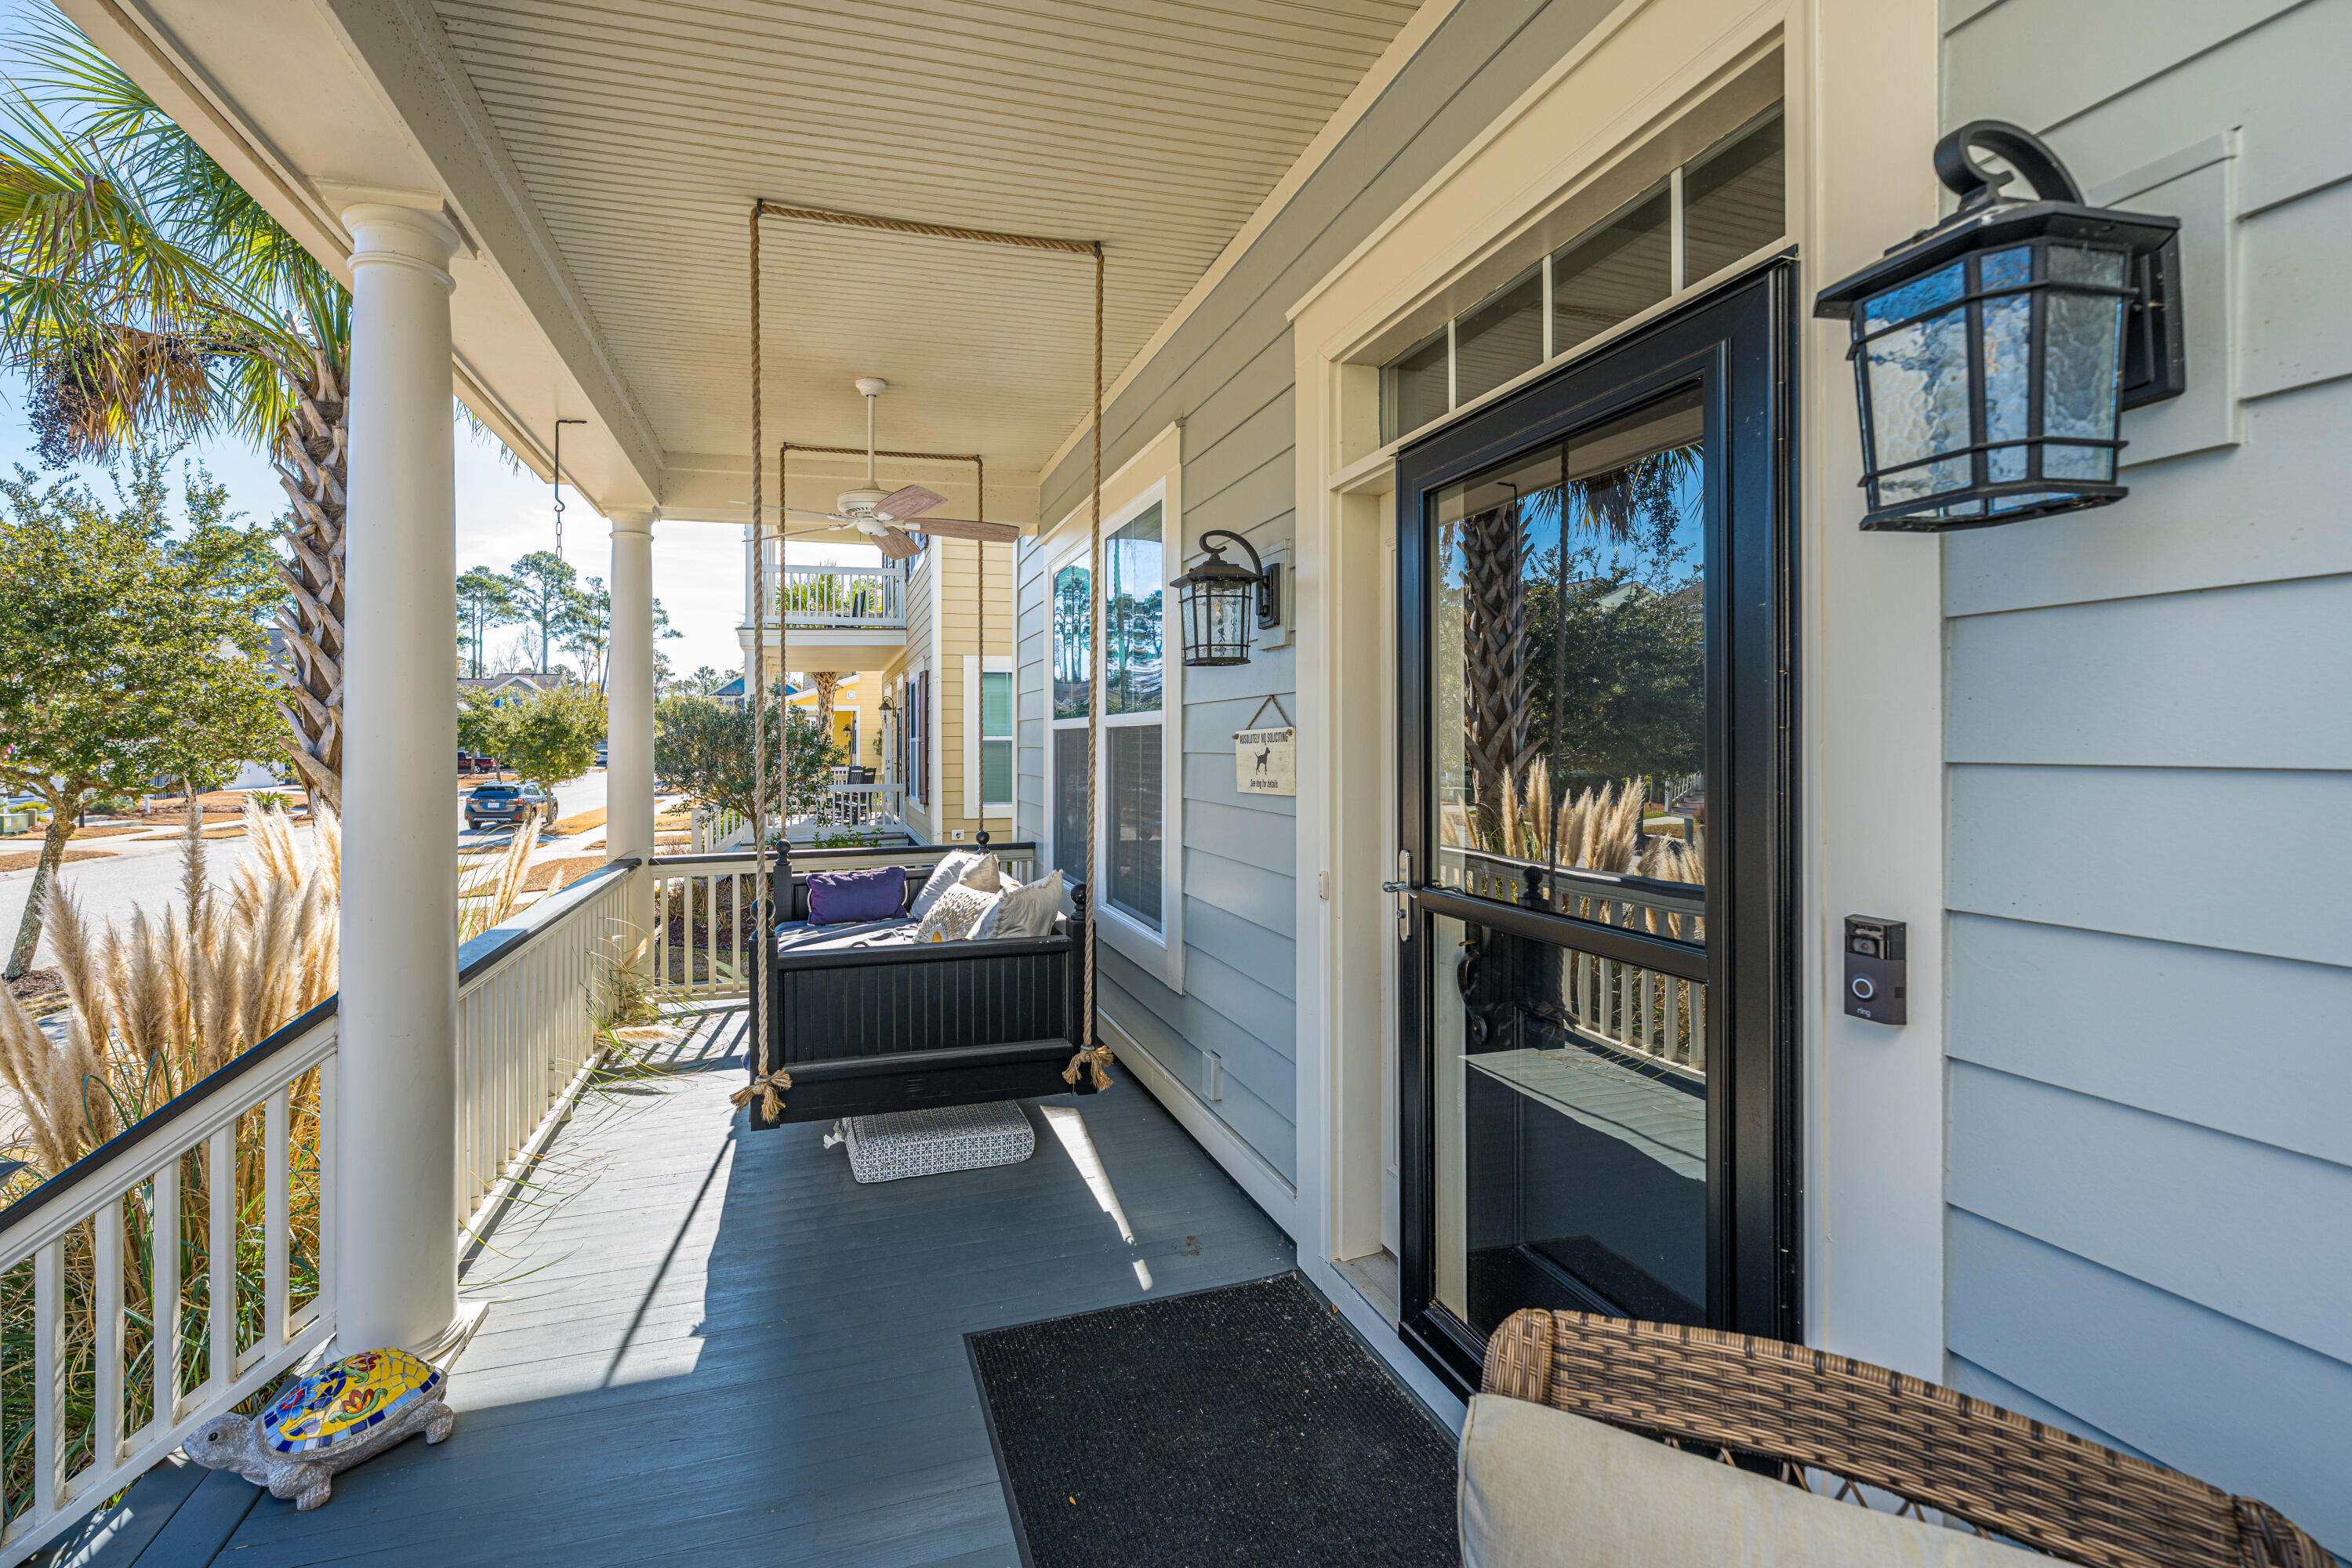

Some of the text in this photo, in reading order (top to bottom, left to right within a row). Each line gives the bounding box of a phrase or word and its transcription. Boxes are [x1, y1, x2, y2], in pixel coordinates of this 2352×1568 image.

[1240, 731, 1288, 744] ABSOLUTELY NO SOLICITING
[1268, 779, 1278, 788] details
[1857, 1007, 1871, 1018] ring
